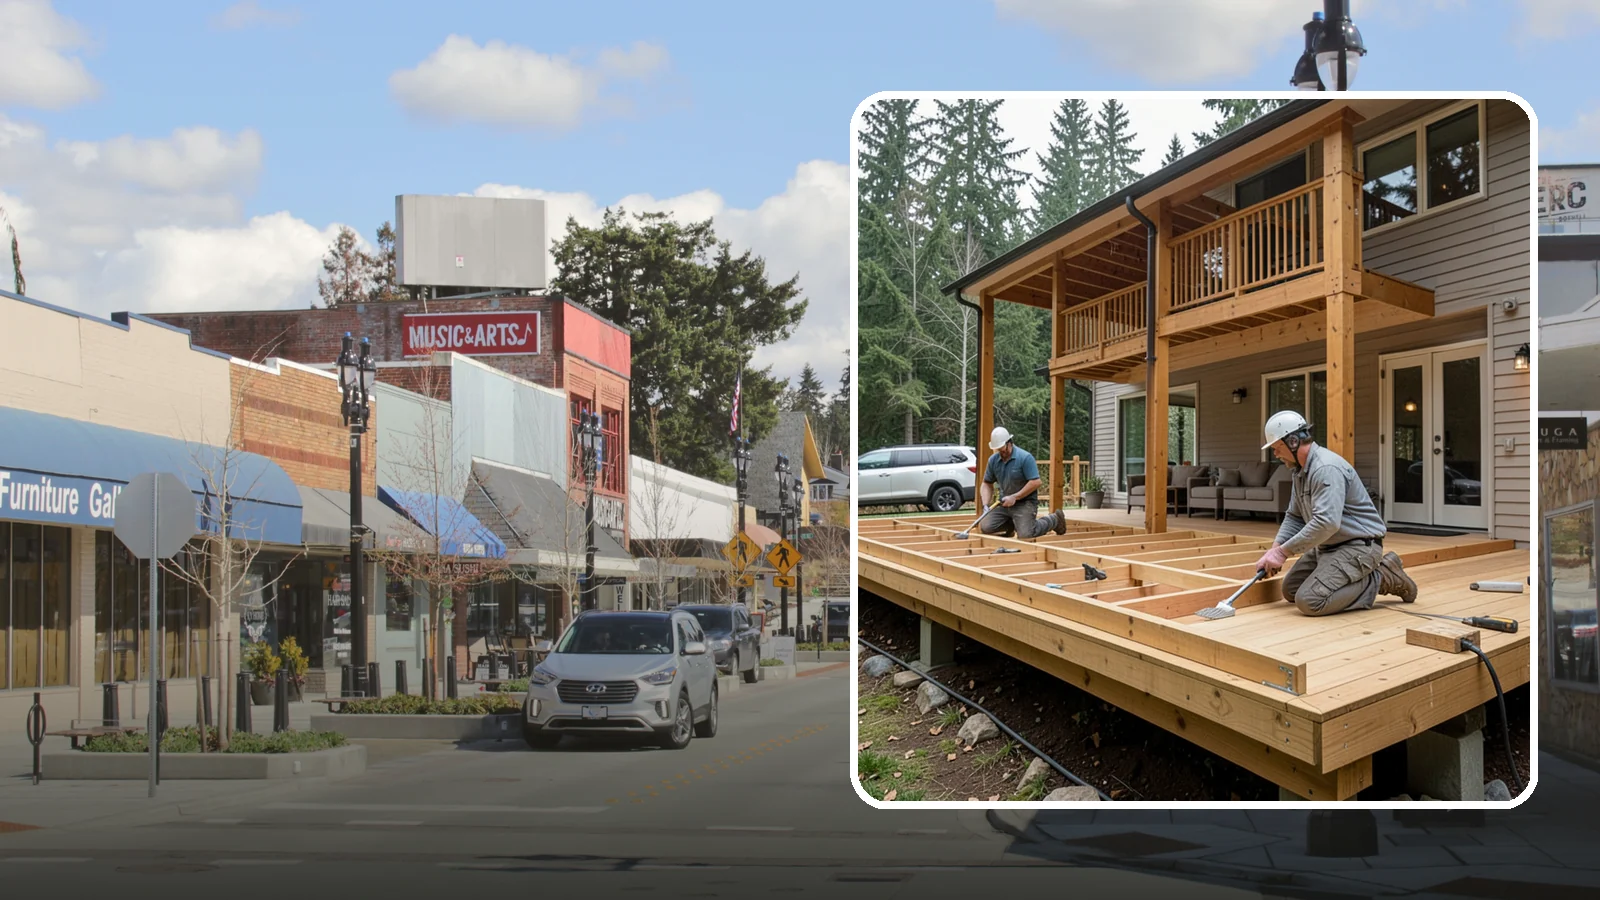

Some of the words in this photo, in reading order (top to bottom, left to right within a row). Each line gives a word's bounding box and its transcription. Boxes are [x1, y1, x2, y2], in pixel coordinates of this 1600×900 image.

[409, 323, 519, 348] MUSIC&ARTS
[0, 471, 79, 515] Furniture
[453, 563, 480, 574] SUSHI
